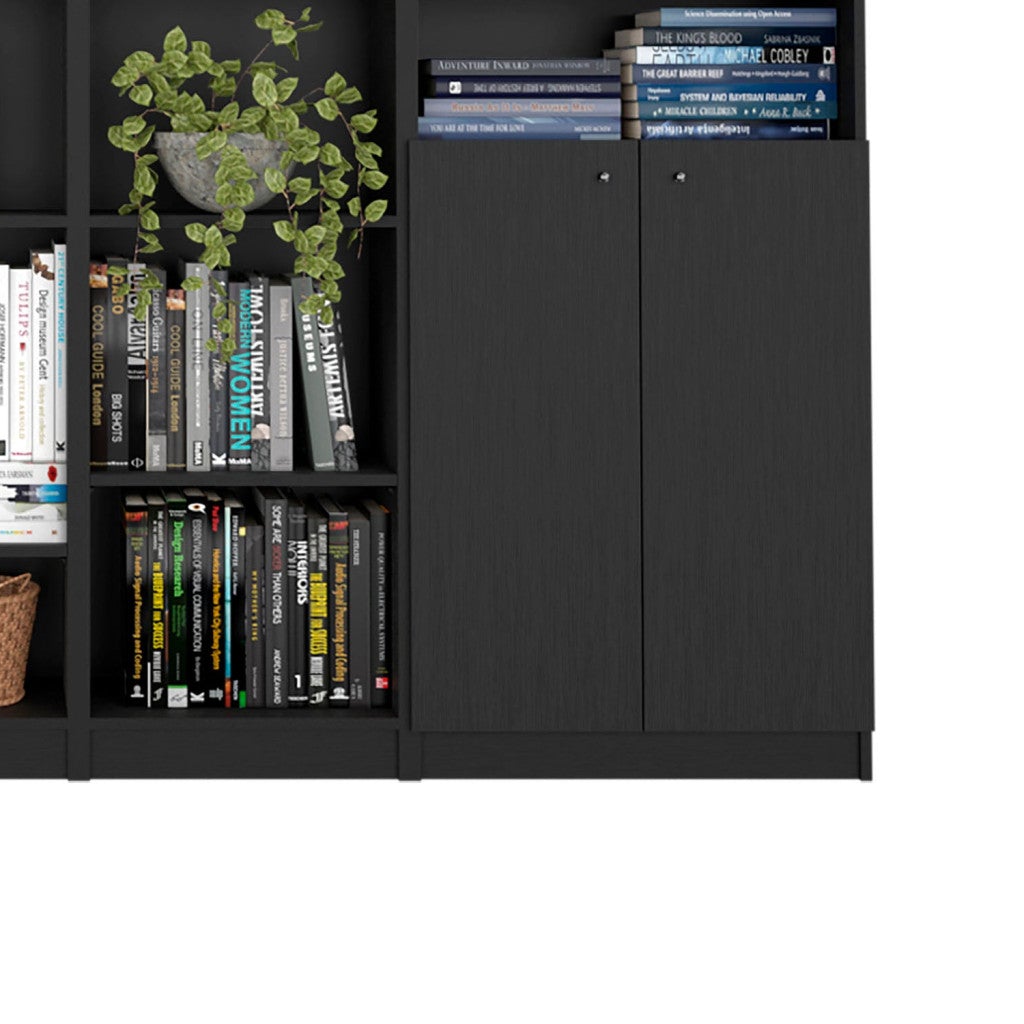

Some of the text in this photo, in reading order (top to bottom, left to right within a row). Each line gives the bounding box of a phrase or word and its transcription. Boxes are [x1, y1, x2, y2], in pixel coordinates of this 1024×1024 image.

[684, 10, 704, 18] Science
[743, 10, 756, 19] using
[758, 10, 772, 19] Open
[655, 32, 672, 44] THE
[709, 32, 742, 44] BLOOD
[724, 48, 810, 63] MICHAEL COBLEY
[473, 84, 487, 92] TIME
[488, 84, 496, 92] OF
[498, 84, 521, 92] HISTORY
[642, 70, 724, 78] THE GREAT BARRIER REEF
[665, 106, 737, 115] MIRACLE CHILDREN
[680, 93, 710, 102] SYSTEM
[712, 93, 727, 102] AND
[728, 93, 763, 102] BAYESIAN
[766, 93, 808, 102] RELIABILITY
[430, 124, 525, 132] YOU ARE AT THE TIME FOR LOVE
[18, 281, 29, 337] TULIPS
[36, 289, 49, 380] Design museum Gent
[152, 316, 163, 352] Guitars
[192, 310, 204, 372] ON LINE
[250, 284, 264, 416] ARTEMIS FOWL
[18, 361, 25, 372] BY
[91, 304, 104, 426] COOL GUIDE London
[170, 325, 181, 432] COOL GUIDE London
[230, 288, 251, 450] MODERN WOMEN
[322, 343, 345, 418] ARTEMIS
[111, 394, 122, 442] BIG SHOTS
[279, 406, 288, 437] WILSON
[152, 444, 160, 467] MoMA
[194, 442, 202, 465] MoMA
[272, 505, 282, 527] SOME
[172, 521, 184, 553] Design
[192, 518, 202, 559] ESSENTIALS
[272, 528, 282, 544] ARE
[174, 554, 184, 598] Research
[192, 560, 202, 569] OF
[251, 570, 258, 581] MY
[296, 540, 308, 605] INTERIORS
[377, 556, 385, 584] QUALITY
[192, 570, 202, 592] VISUAL
[272, 572, 282, 594] THAN
[132, 555, 142, 680] Audio Signal Processing and Coding
[192, 594, 202, 652] COMMUNICATION
[272, 594, 282, 624] OTHERS
[332, 562, 347, 682] Audio Signal Processing and Coding
[273, 648, 281, 704] ANDREW SEAWARD
